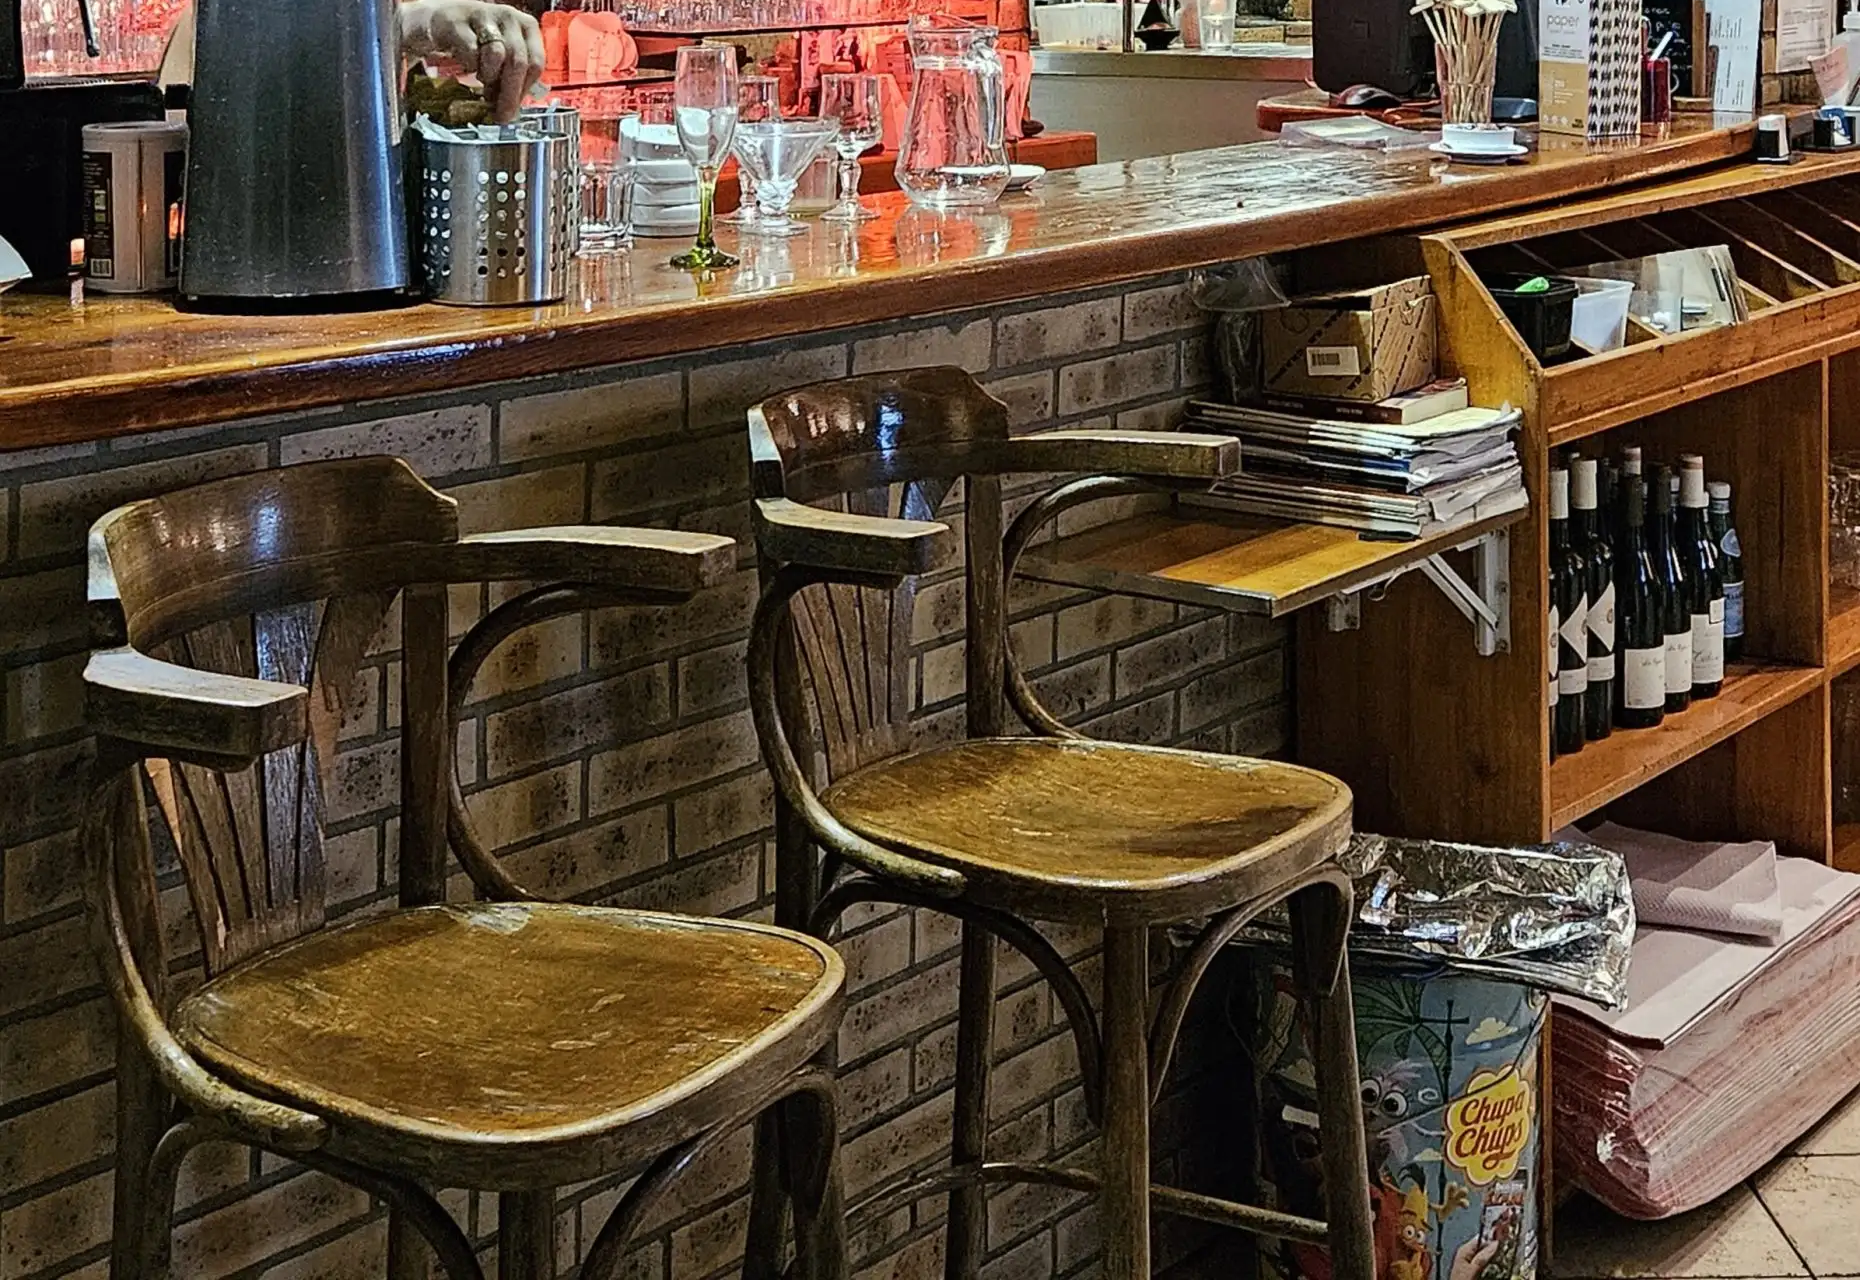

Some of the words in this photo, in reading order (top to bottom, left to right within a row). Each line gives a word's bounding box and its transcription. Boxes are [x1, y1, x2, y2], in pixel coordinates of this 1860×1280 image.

[1547, 14, 1579, 30] paper
[1459, 1090, 1526, 1128] Chupa
[1455, 1117, 1524, 1171] Chups
